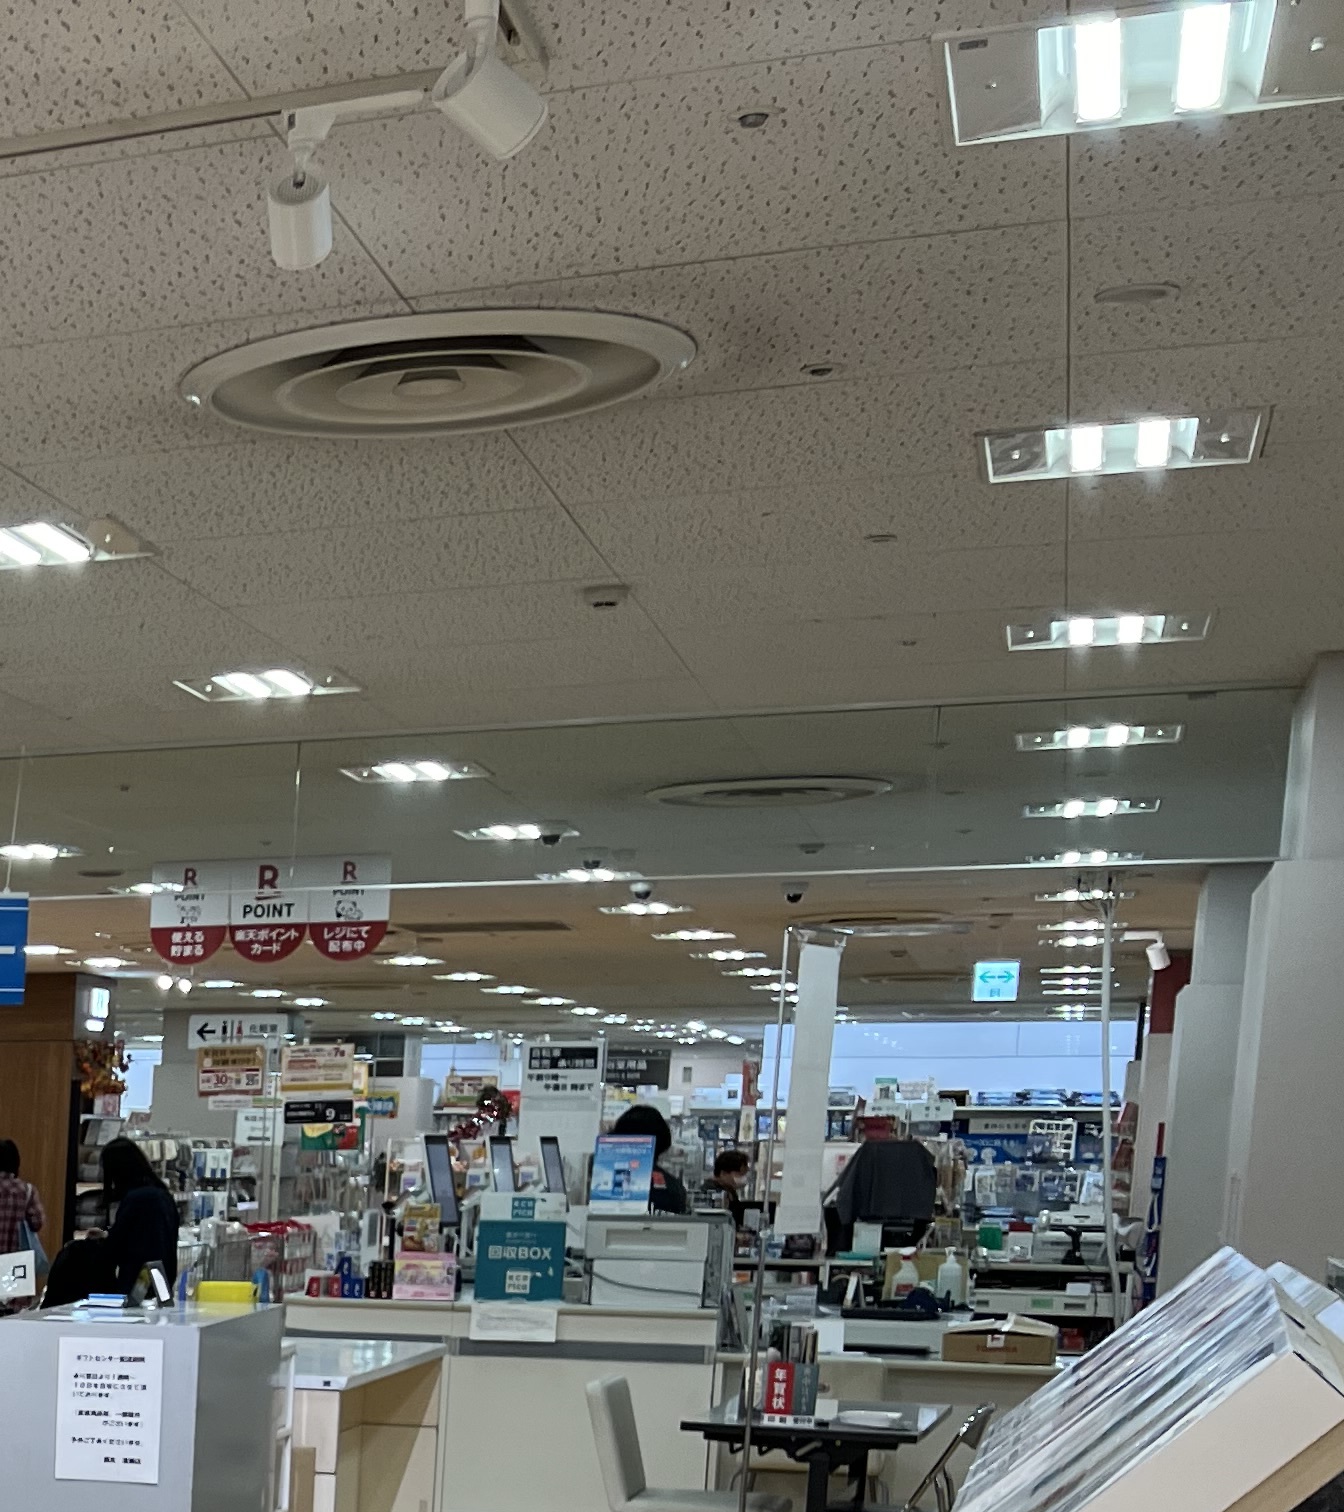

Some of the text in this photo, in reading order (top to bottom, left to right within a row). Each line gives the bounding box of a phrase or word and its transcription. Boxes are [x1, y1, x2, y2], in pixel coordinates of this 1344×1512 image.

[242, 903, 295, 919] POINT
[323, 926, 370, 939] レジにて
[250, 942, 282, 956] カード
[488, 1245, 552, 1261] 回収BOX
[771, 1368, 787, 1410] 年賀状
